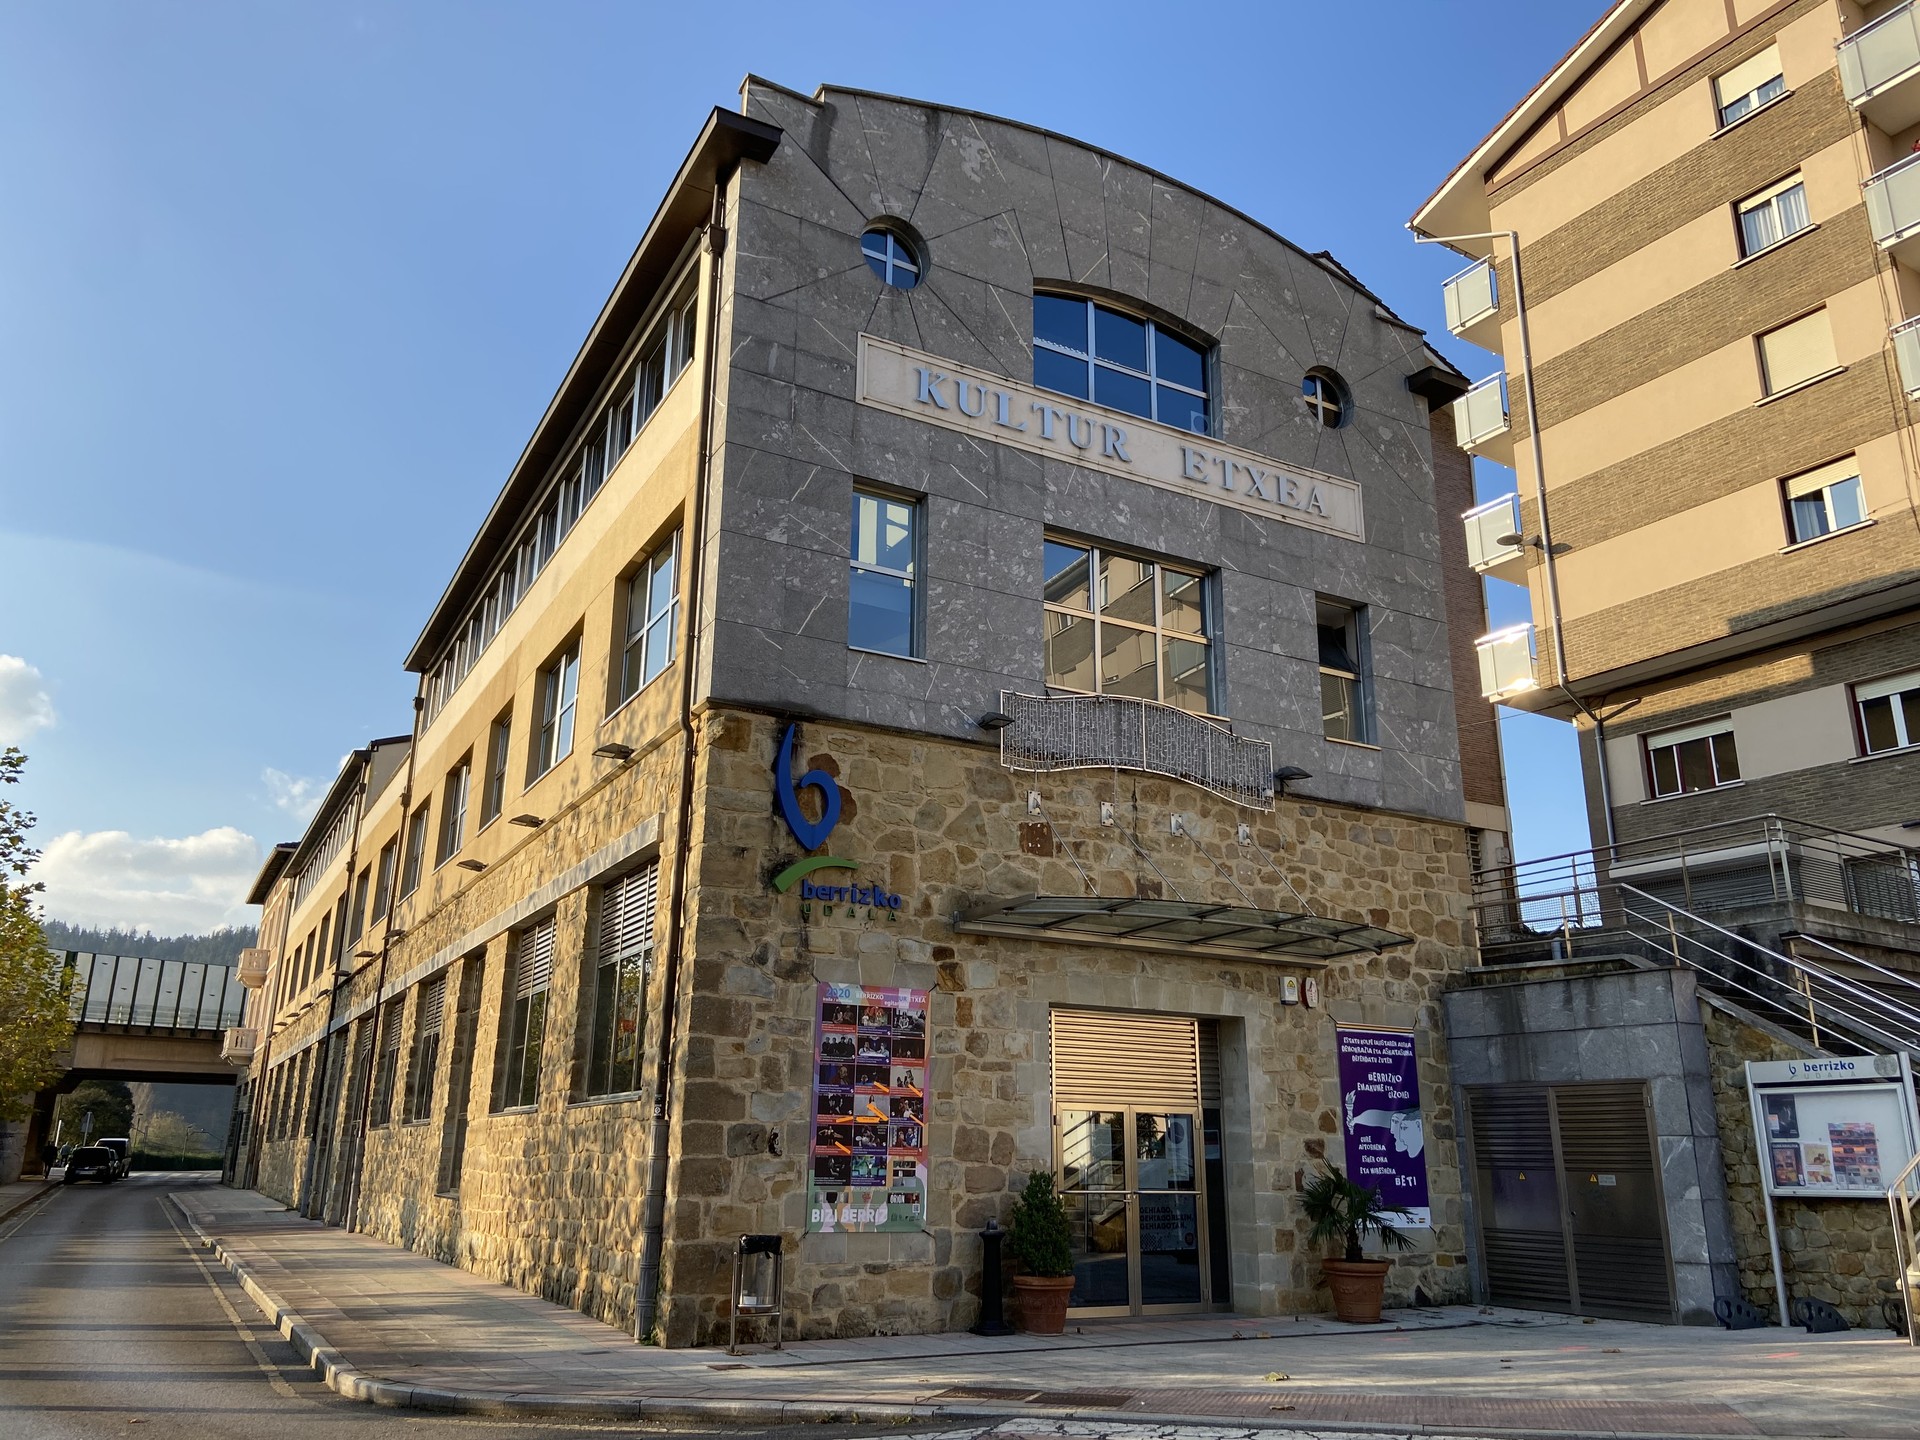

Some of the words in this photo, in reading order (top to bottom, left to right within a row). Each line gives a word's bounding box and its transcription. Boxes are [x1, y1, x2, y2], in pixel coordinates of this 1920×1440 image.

[914, 366, 1133, 463] KULTUR
[1181, 446, 1332, 518] ETXEA
[802, 879, 902, 909] berrizko
[800, 903, 898, 922] UDALA
[826, 987, 851, 999] 2020
[1341, 1045, 1372, 1054] DEMOKRAZIA
[1803, 1060, 1855, 1072] berrizko
[1367, 1071, 1403, 1084] BERRIZKO
[1803, 1071, 1857, 1080] UDALA
[1356, 1082, 1385, 1092] EMAKUME
[1388, 1090, 1410, 1099] GIZONEI
[1359, 1166, 1370, 1174] ETA
[1394, 1174, 1418, 1187] BETI
[811, 1207, 838, 1223] BIZI
[840, 1207, 888, 1223] BERRIZ
